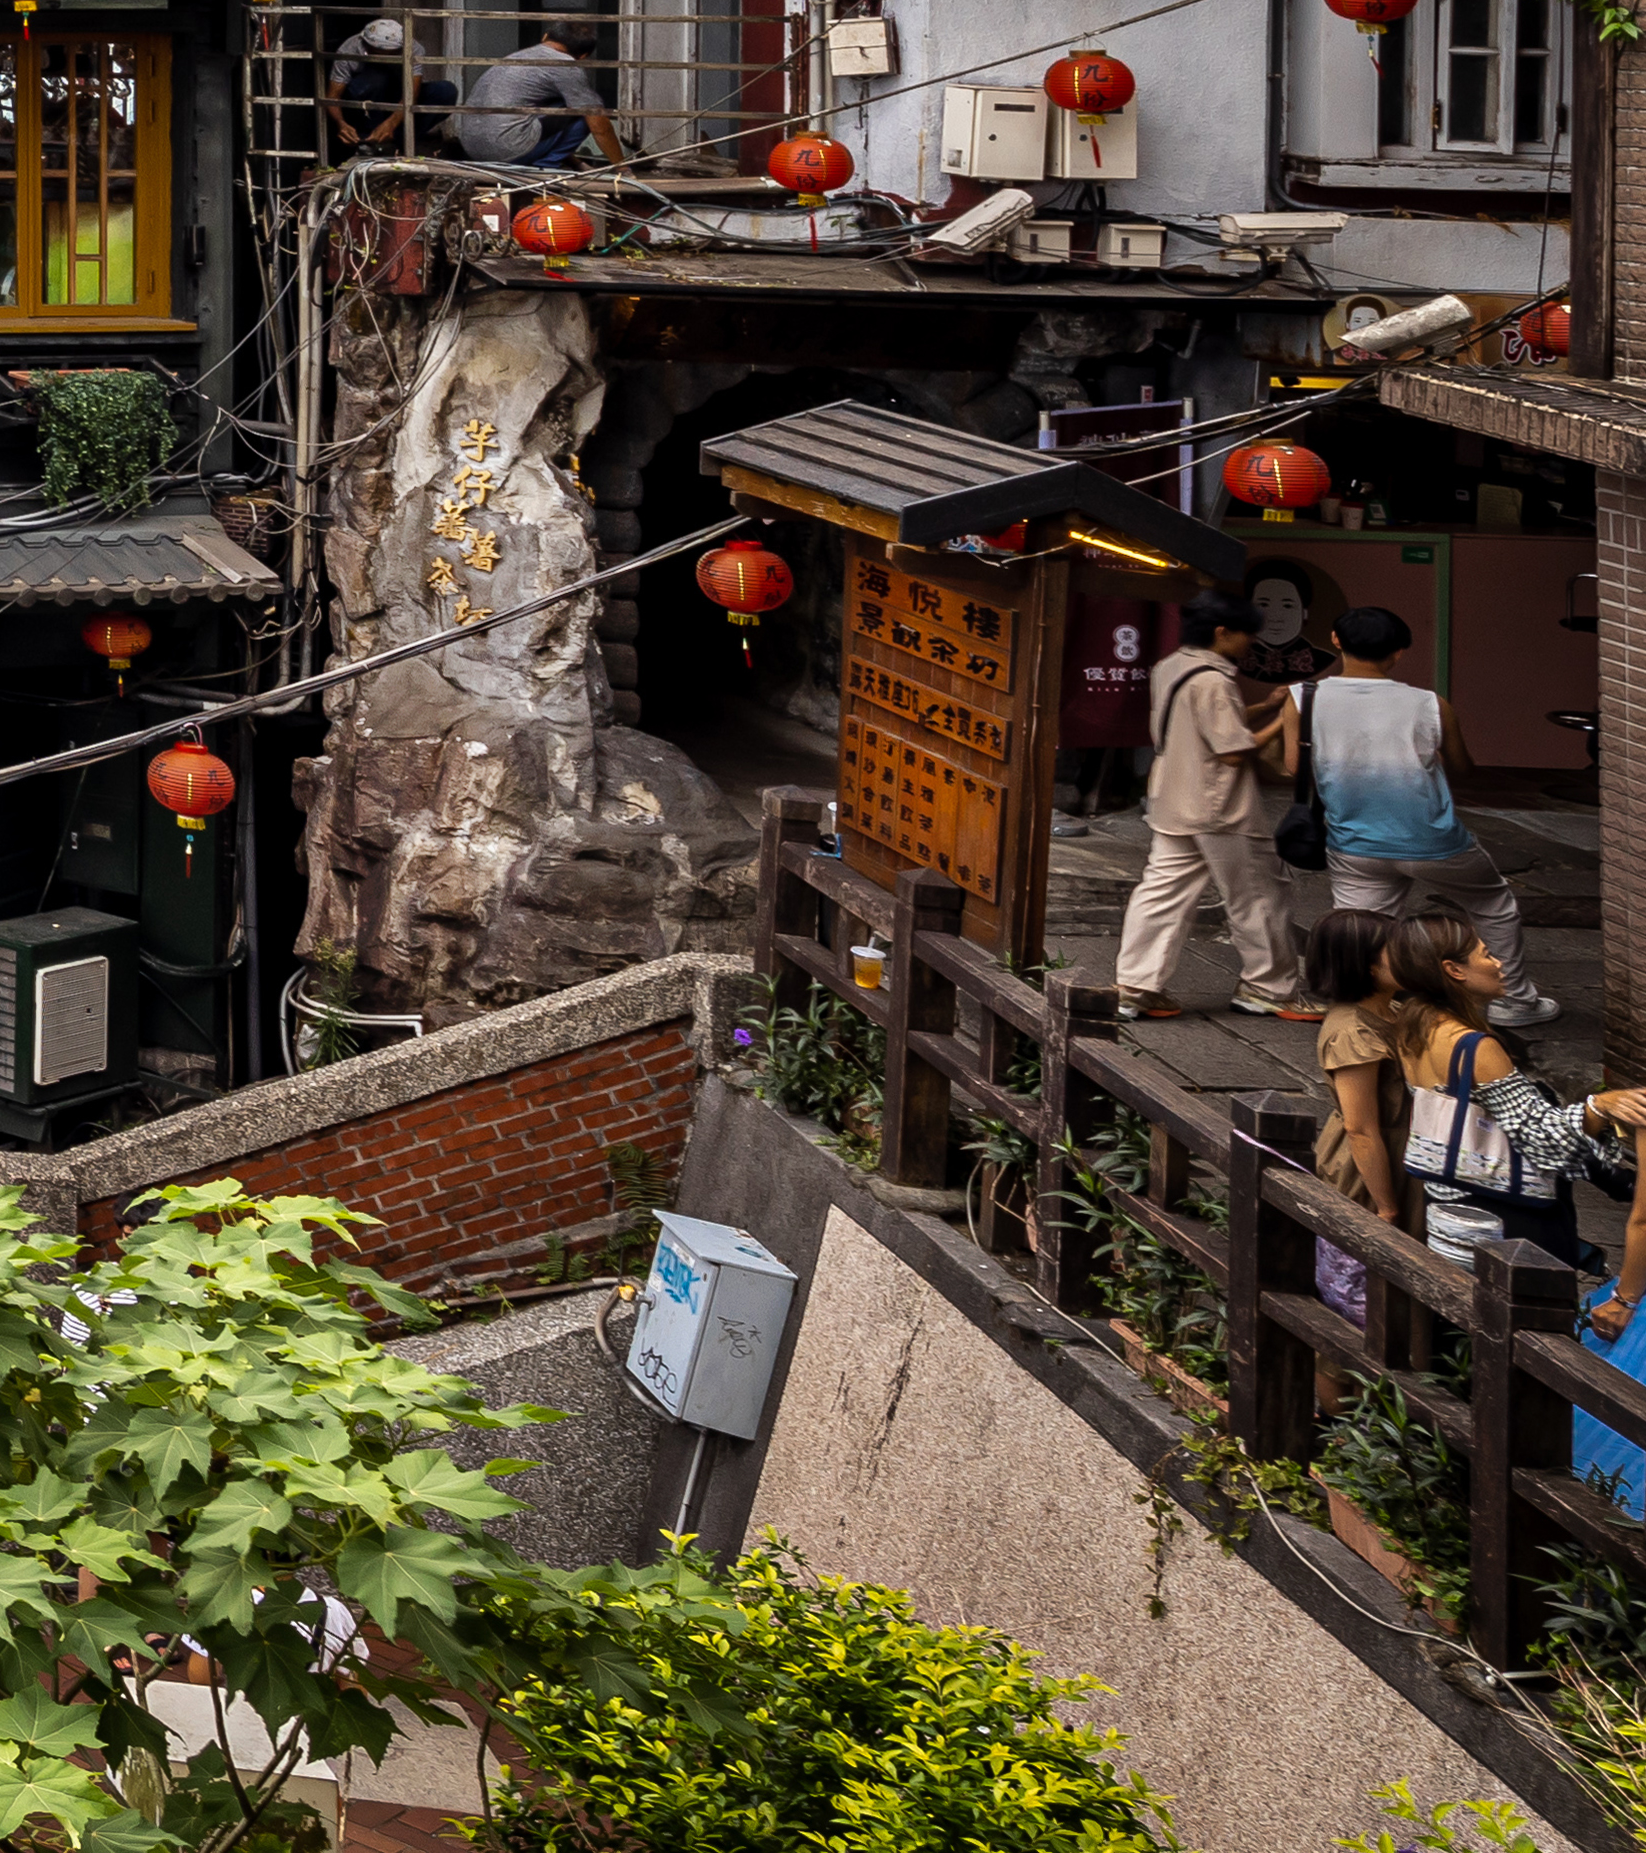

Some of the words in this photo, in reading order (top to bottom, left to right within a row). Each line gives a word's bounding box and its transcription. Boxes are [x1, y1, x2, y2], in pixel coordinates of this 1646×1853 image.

[1082, 64, 1108, 110] 九份
[794, 147, 820, 189] 九份
[525, 215, 552, 255] 九份
[1246, 454, 1275, 505] 九份
[857, 561, 1002, 643] 海悅樓
